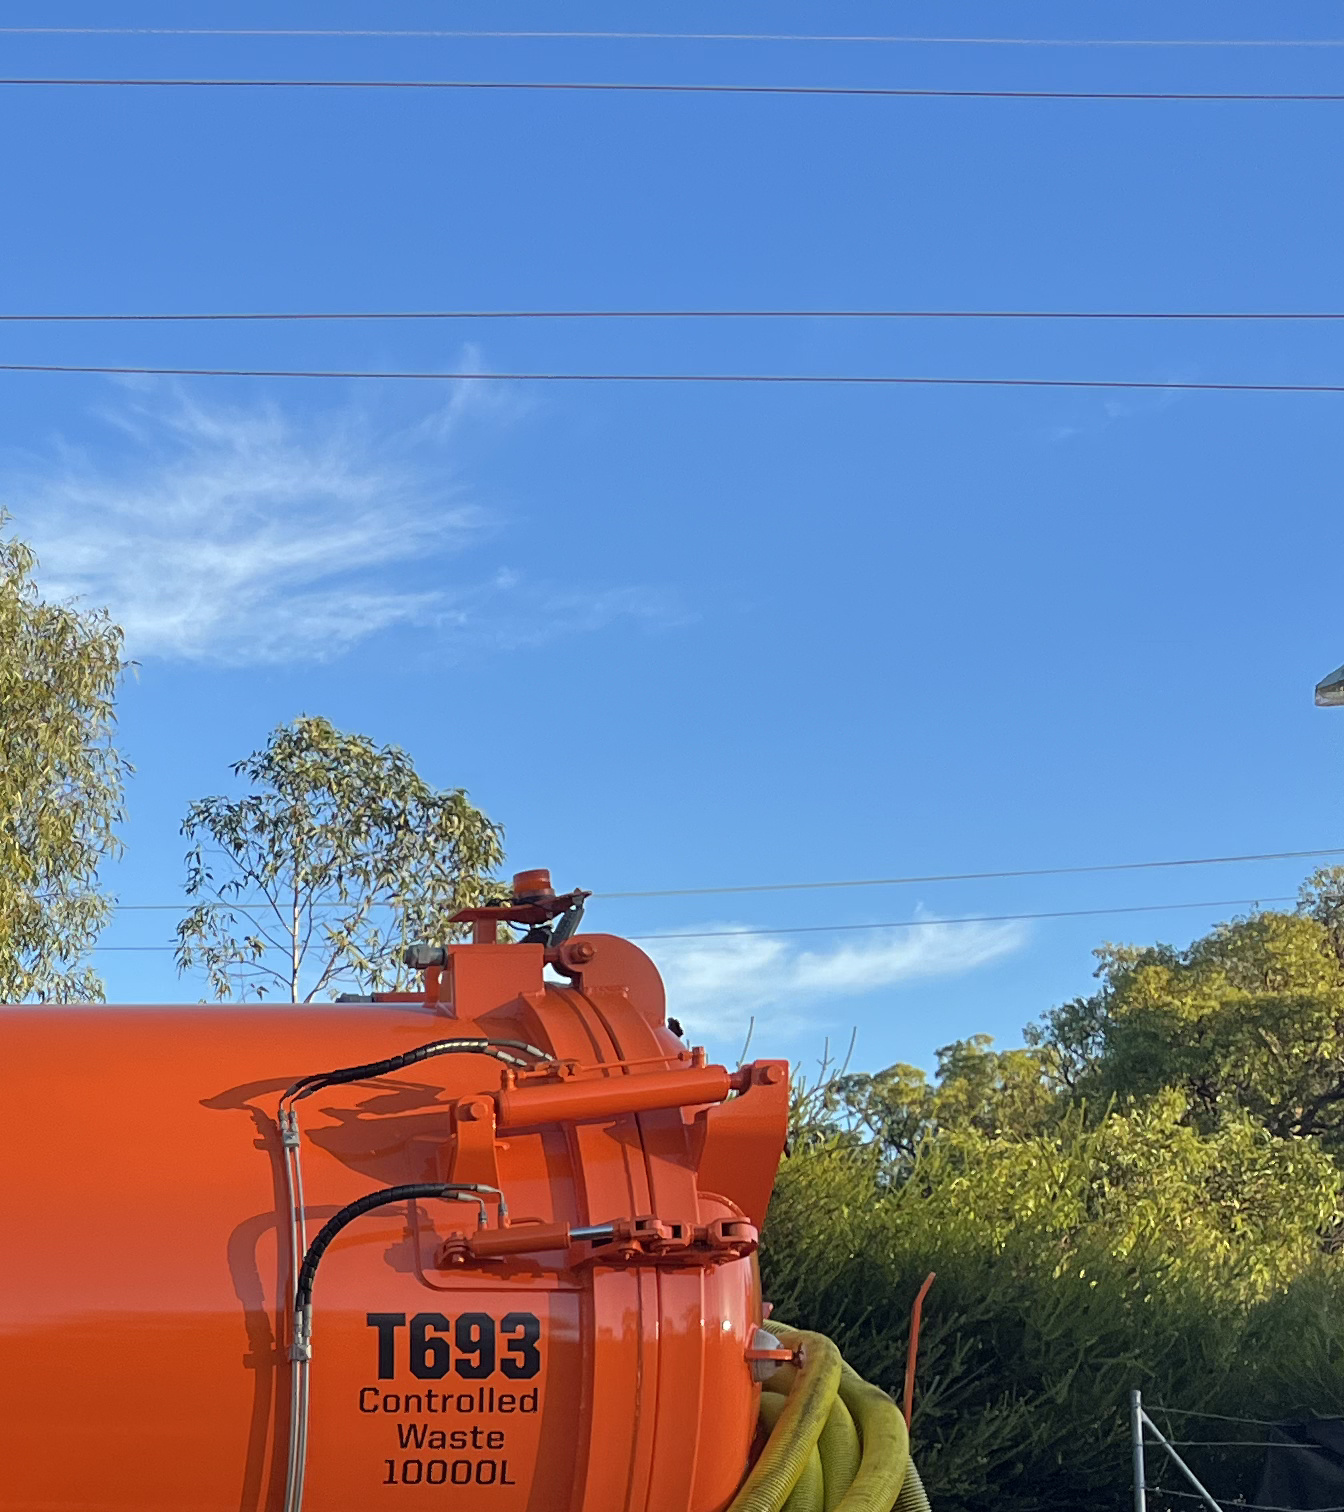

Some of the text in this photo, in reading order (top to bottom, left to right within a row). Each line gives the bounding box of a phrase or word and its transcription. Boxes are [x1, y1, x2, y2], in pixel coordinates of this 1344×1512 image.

[366, 1312, 541, 1380] T693
[358, 1387, 539, 1414] Controlled
[397, 1424, 505, 1450] Waste
[382, 1459, 516, 1485] 10000L
